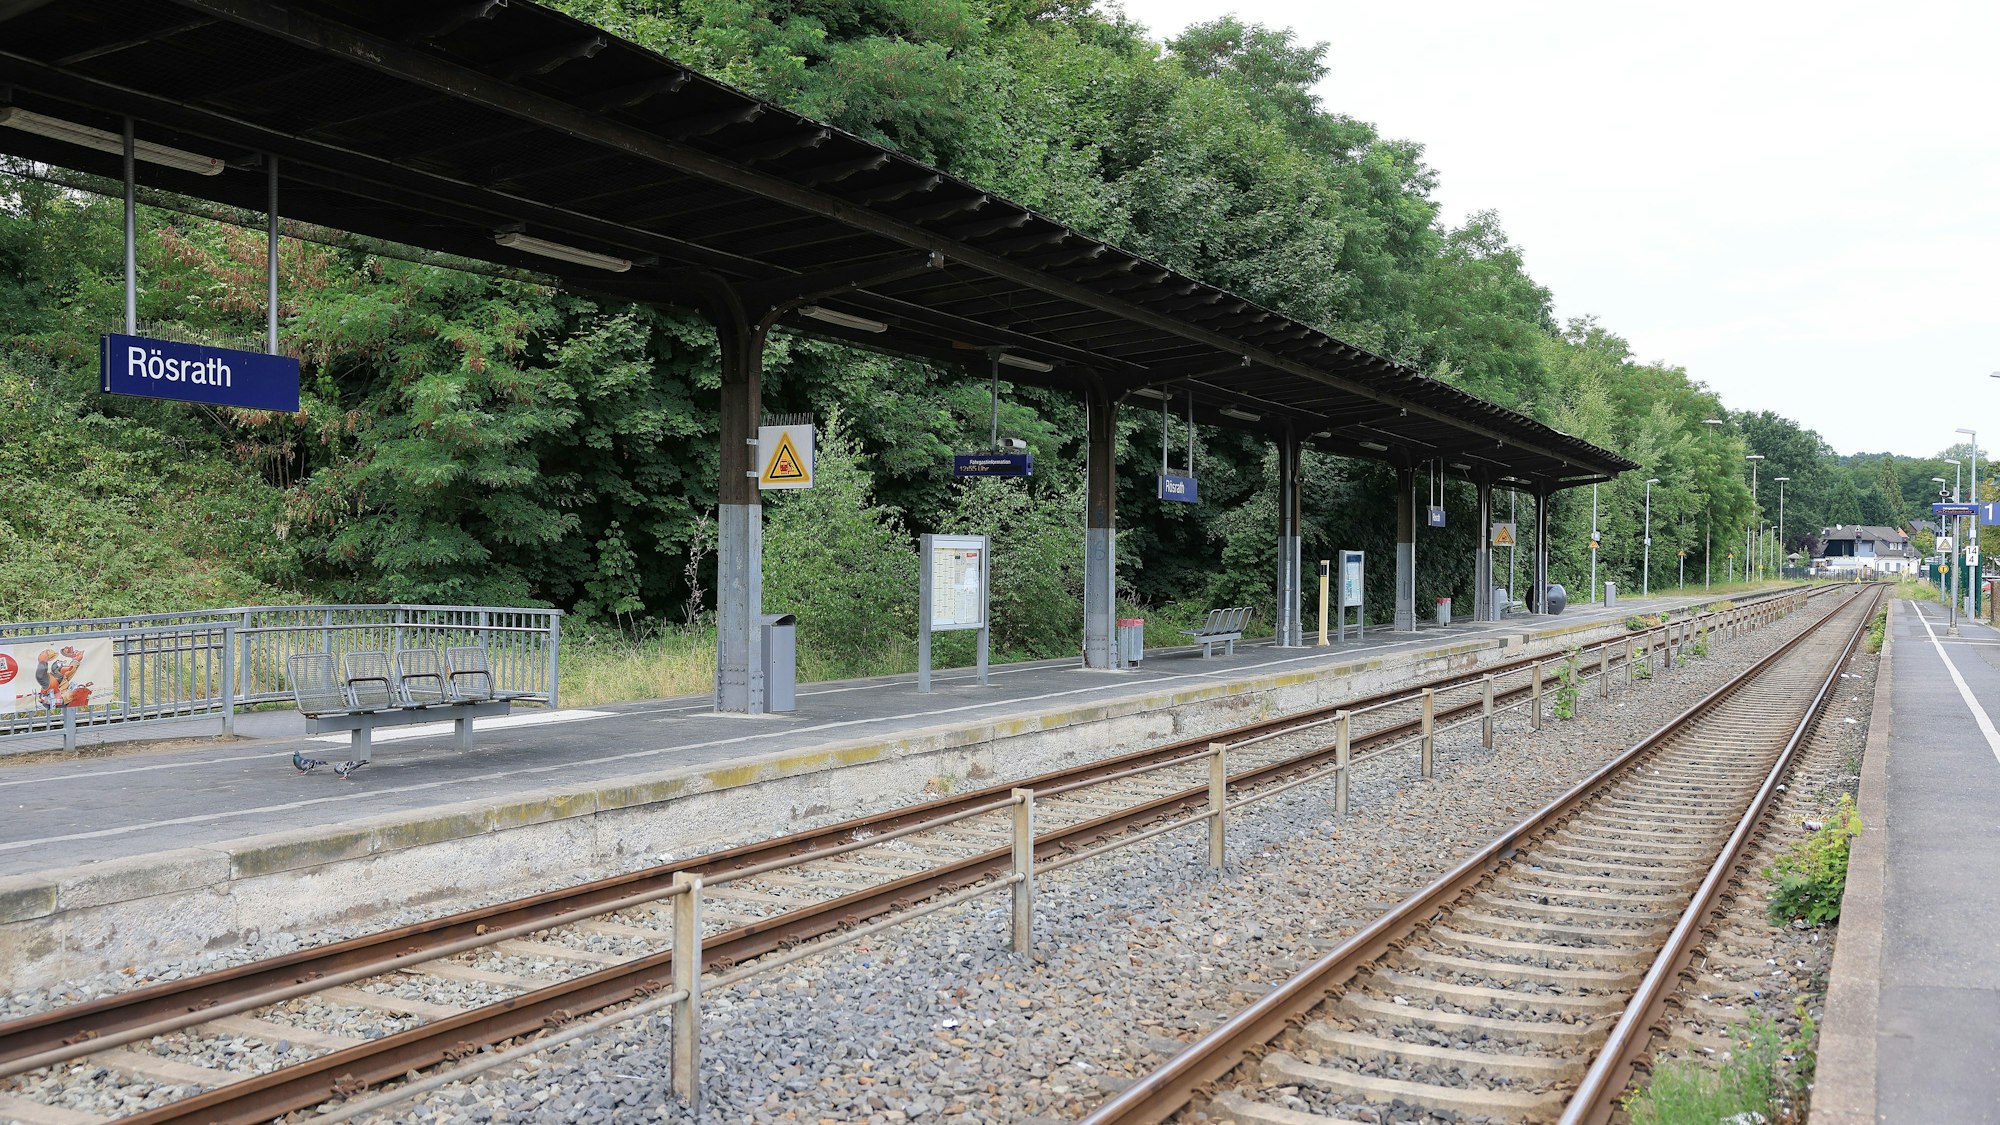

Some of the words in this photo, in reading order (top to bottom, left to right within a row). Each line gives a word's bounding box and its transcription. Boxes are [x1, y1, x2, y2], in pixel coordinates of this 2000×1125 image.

[128, 346, 232, 387] Rösrath
[1165, 479, 1185, 494] Rösrath
[1984, 503, 1993, 520] 1
